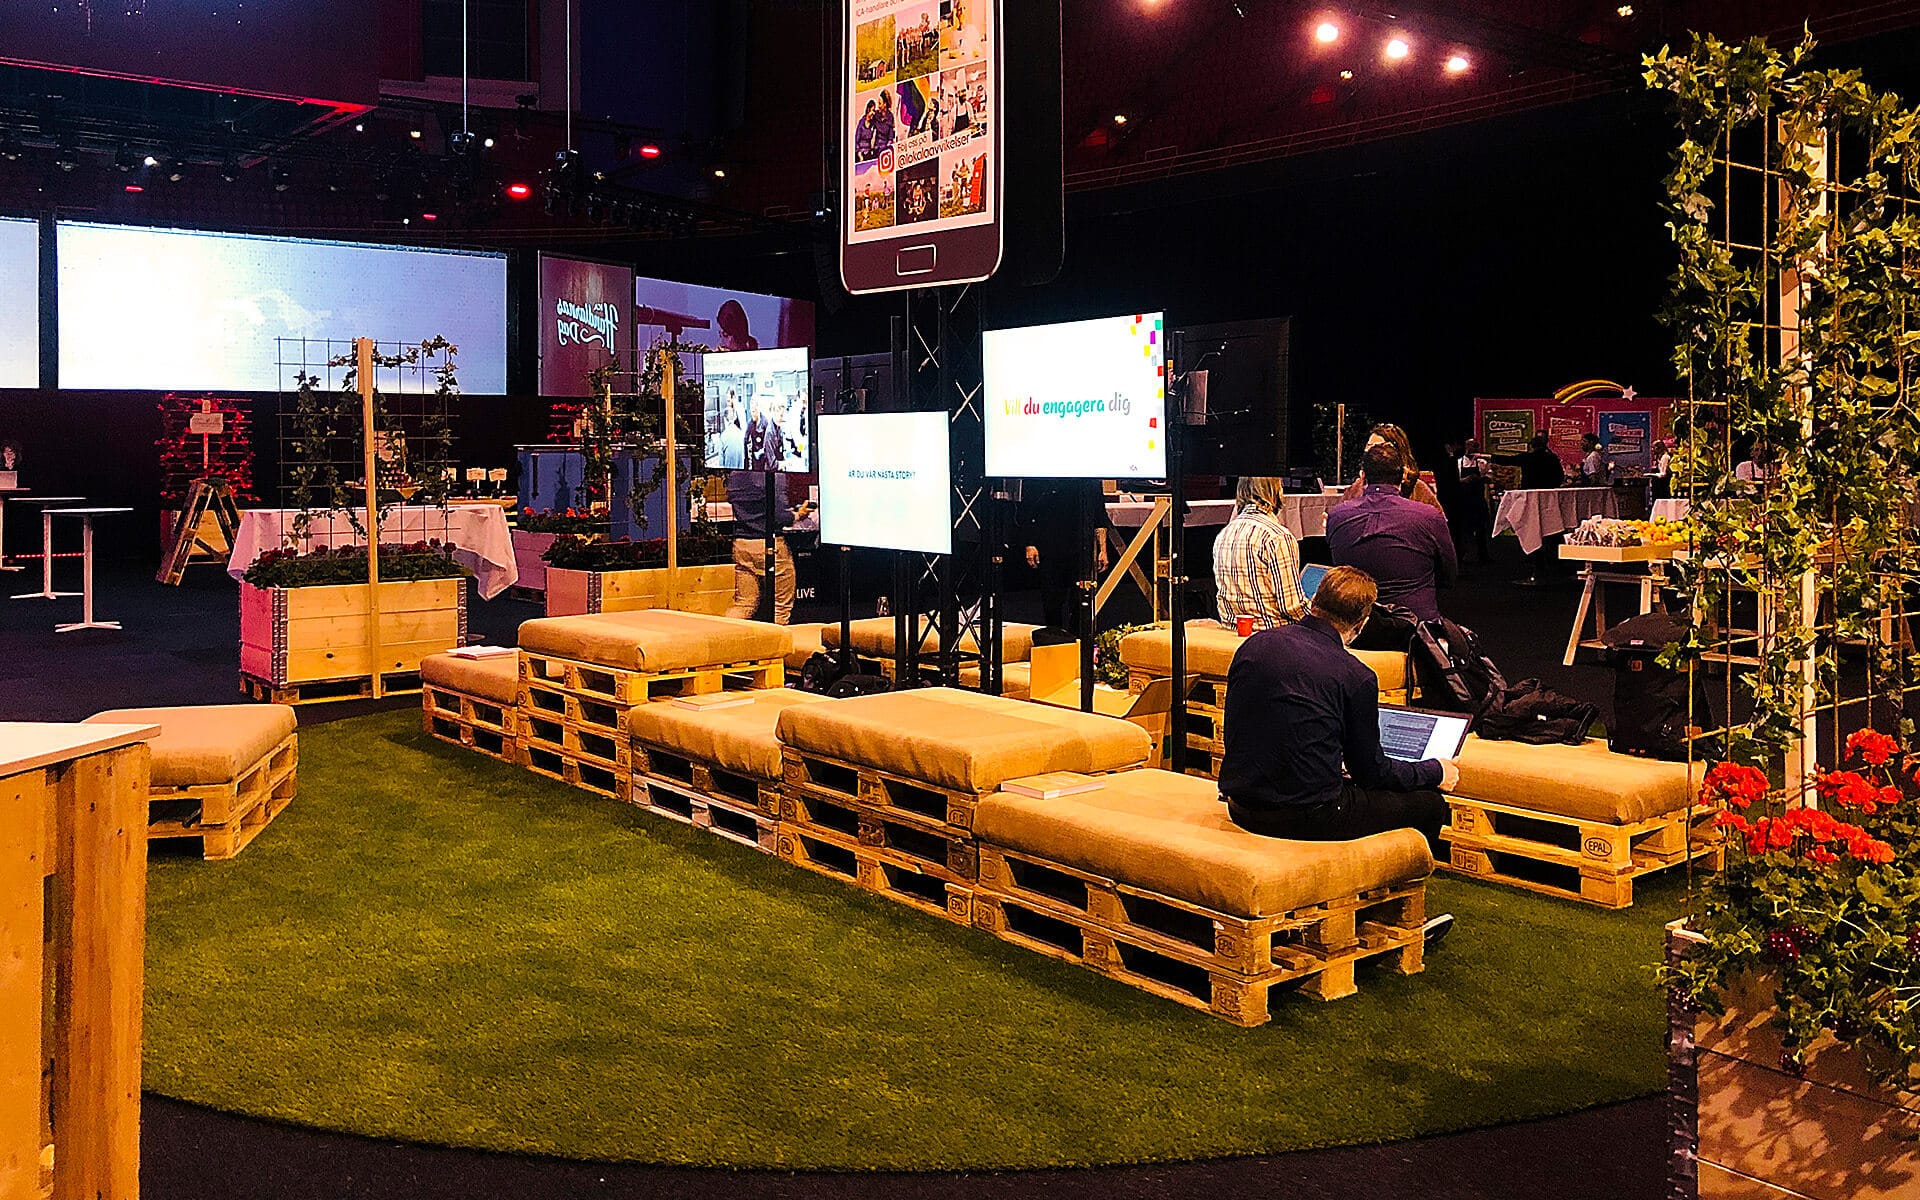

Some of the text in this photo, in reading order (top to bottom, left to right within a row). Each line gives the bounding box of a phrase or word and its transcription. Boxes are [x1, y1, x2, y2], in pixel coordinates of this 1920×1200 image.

[1003, 391, 1131, 418] Vill du engagera dig
[796, 587, 816, 599] LIVE
[1588, 840, 1608, 854] EPAL
